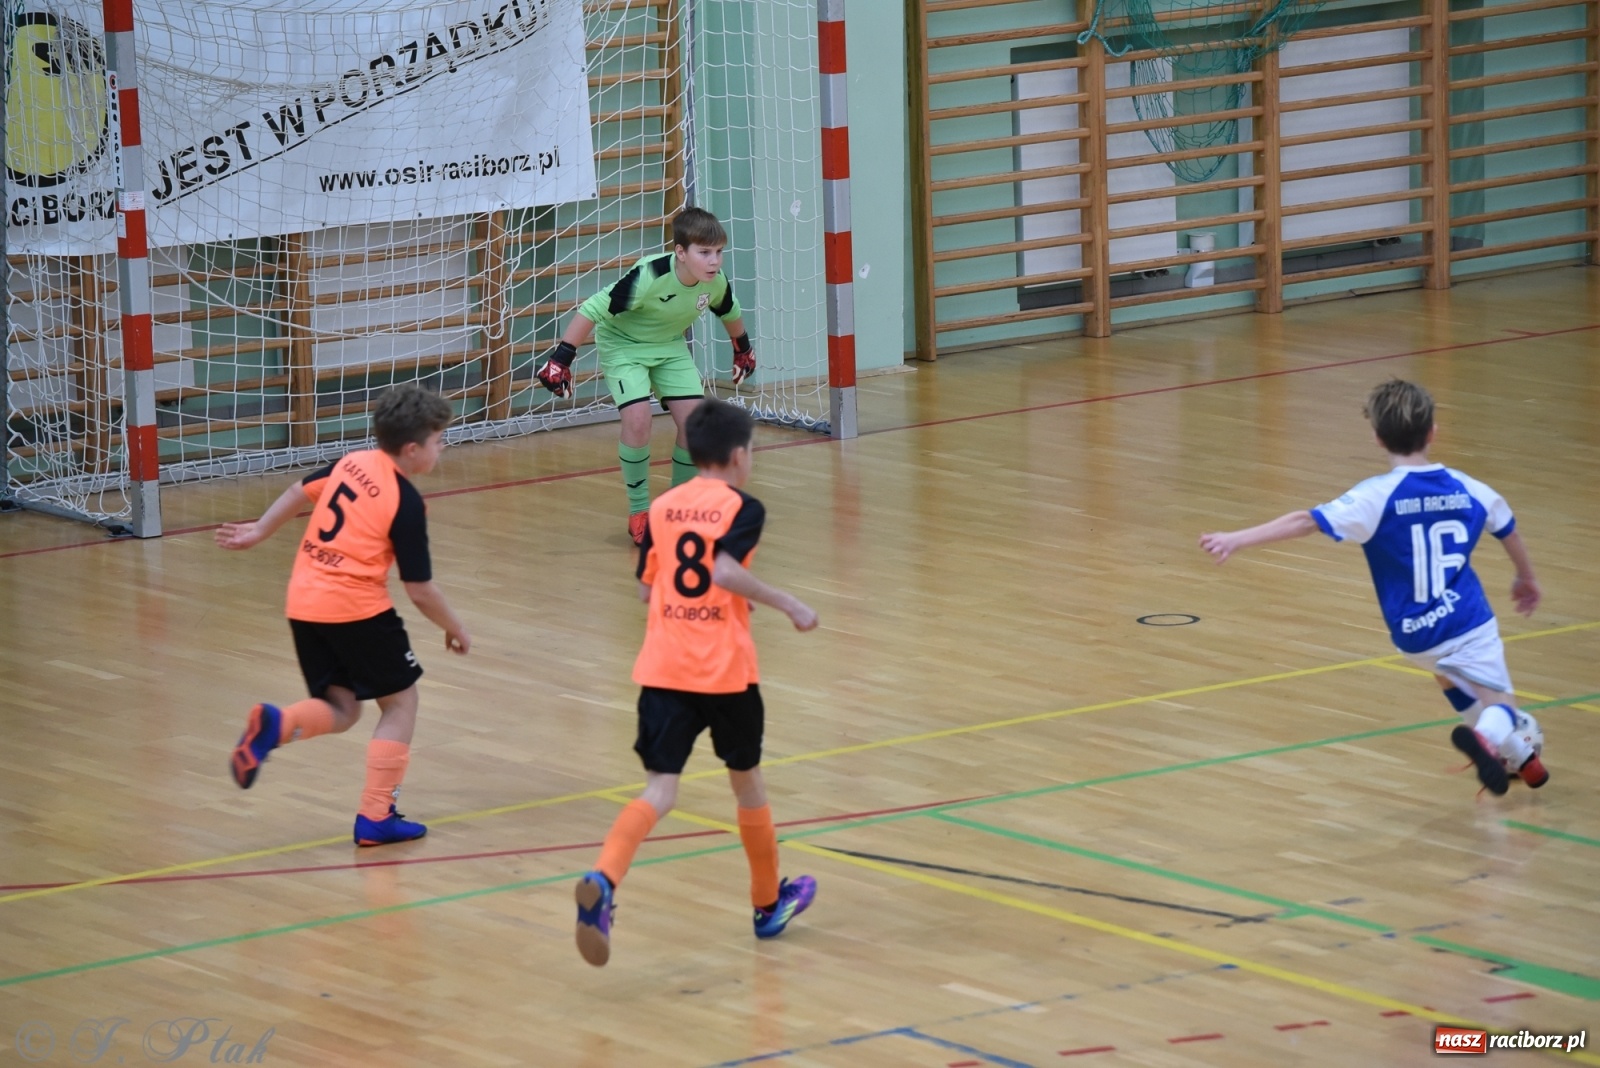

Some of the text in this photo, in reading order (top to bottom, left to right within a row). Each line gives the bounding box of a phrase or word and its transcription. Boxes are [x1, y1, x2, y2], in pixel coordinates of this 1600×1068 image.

[152, 121, 252, 200] JEST
[262, 97, 305, 147] W
[319, 145, 560, 193] www.osir-raciborz.pl
[342, 460, 381, 498] RAFAKO
[318, 481, 358, 543] 5
[665, 508, 722, 523] RAFAKO
[674, 531, 711, 598] 8
[1411, 519, 1469, 603] 16
[405, 651, 418, 668] 5
